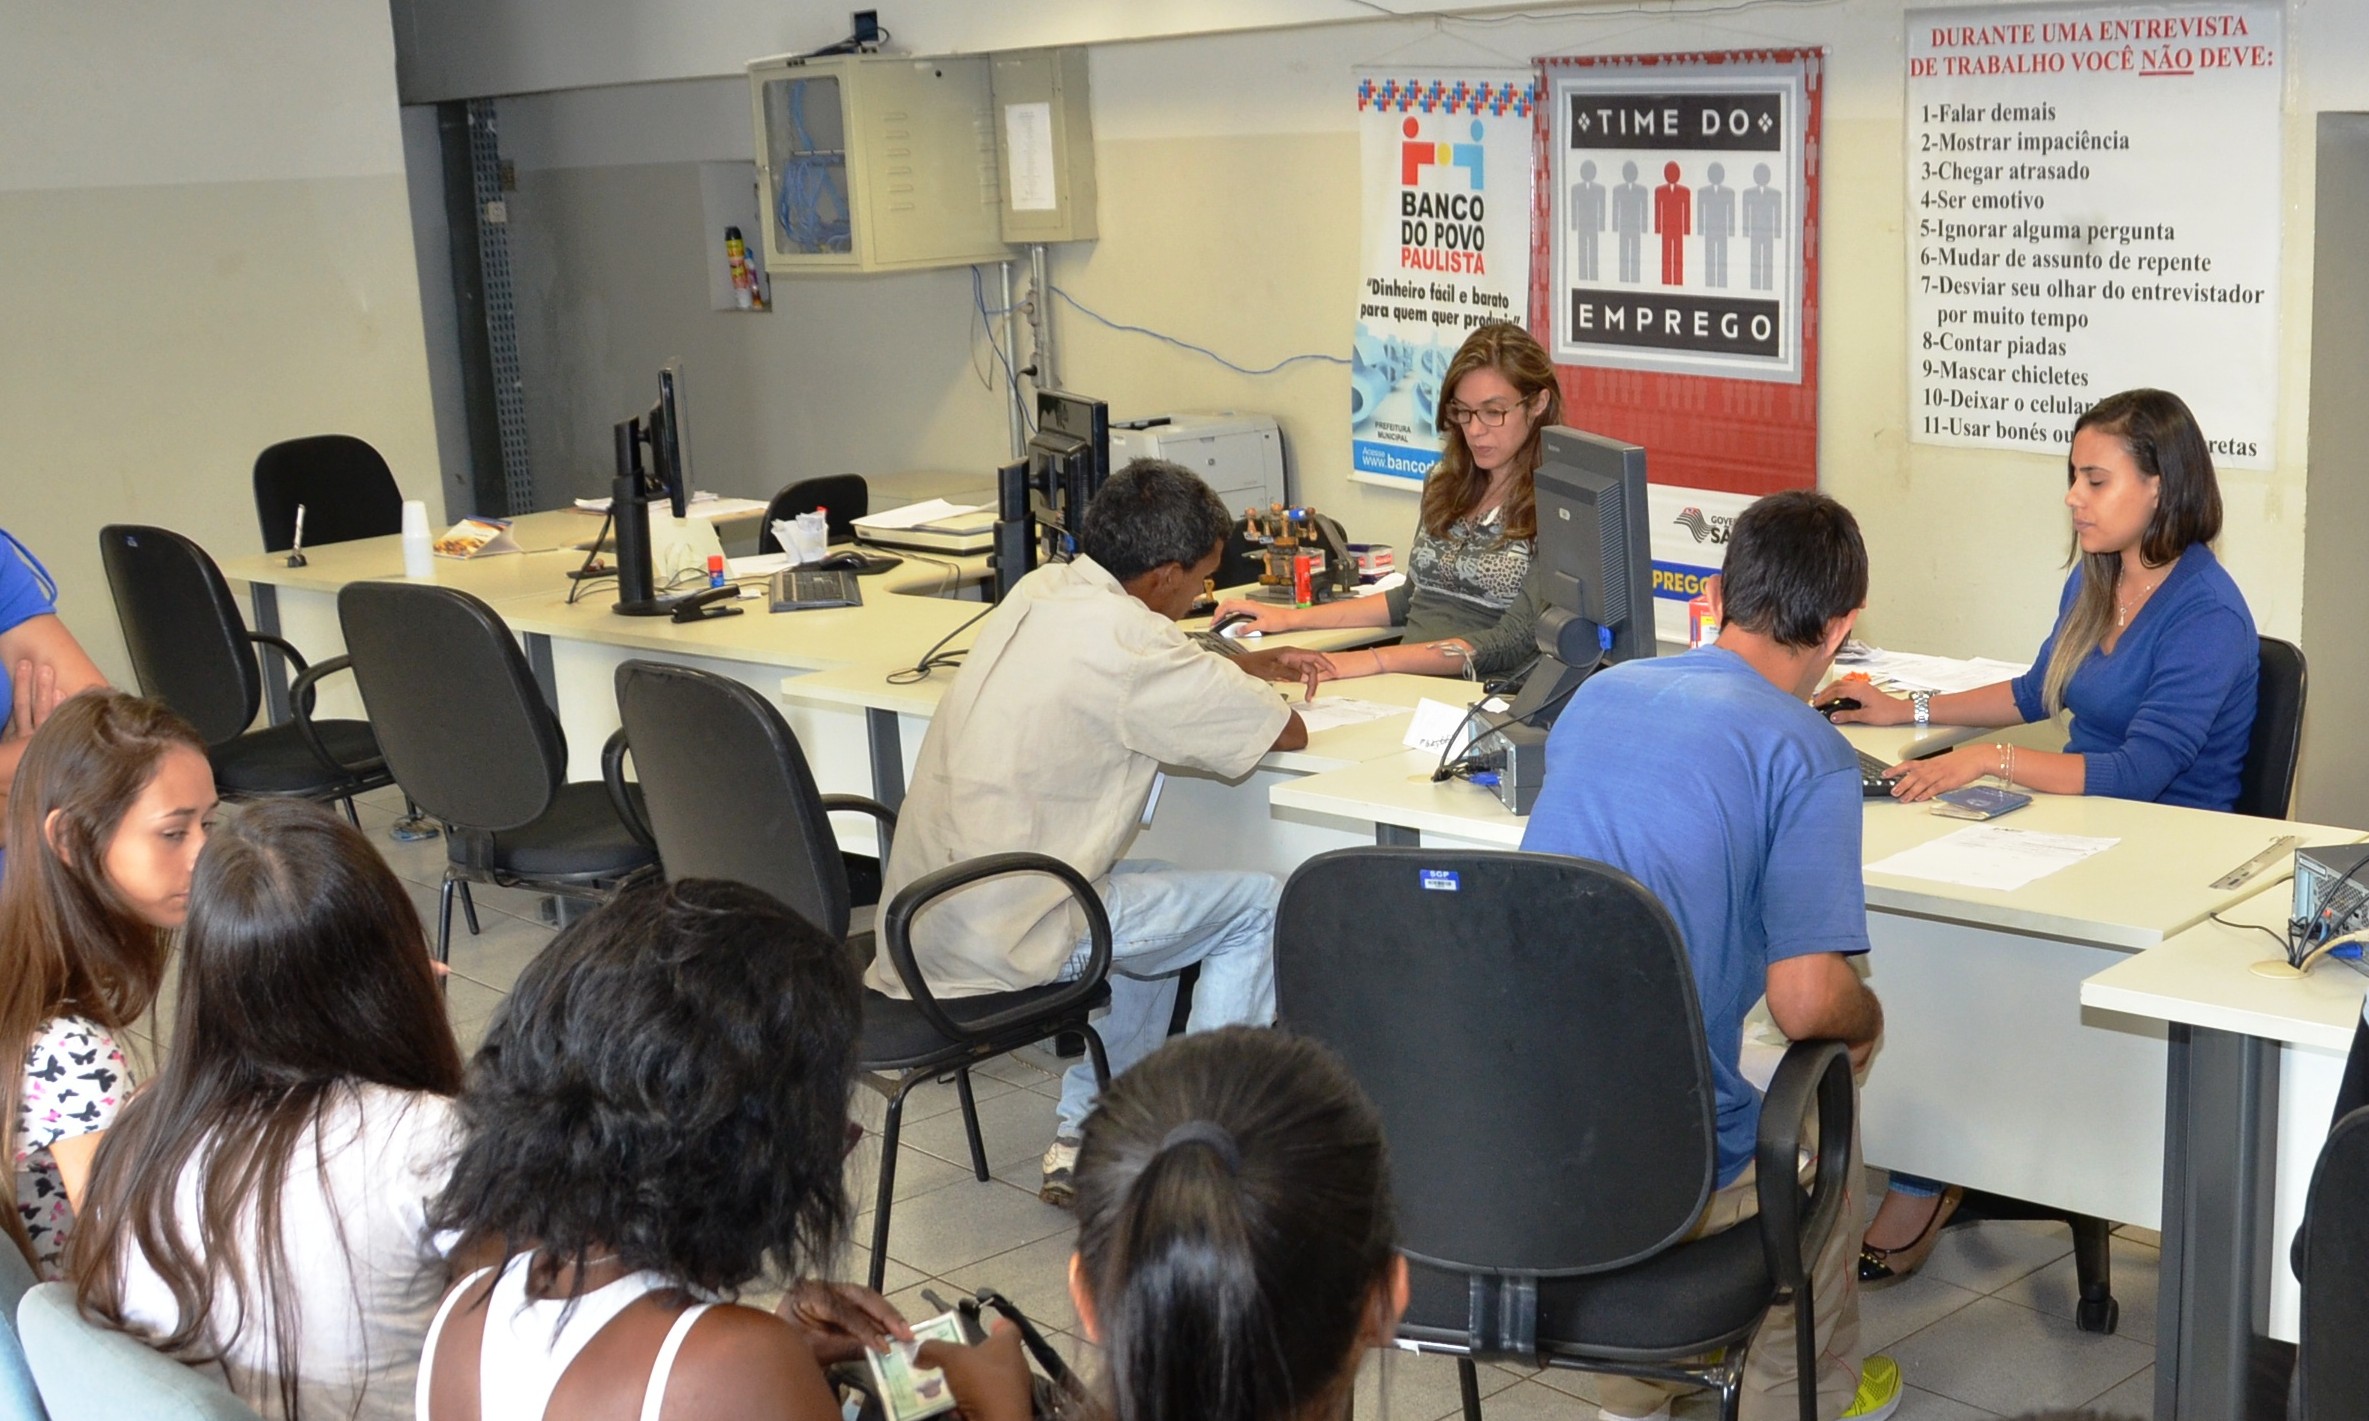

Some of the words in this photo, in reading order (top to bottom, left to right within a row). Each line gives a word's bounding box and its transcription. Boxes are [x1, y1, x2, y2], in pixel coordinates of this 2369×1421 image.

[1931, 24, 2035, 47] DURANTE
[2042, 22, 2094, 43] UMA
[2100, 15, 2249, 41] ENTREVISTA
[1910, 57, 1938, 77] DE
[1943, 52, 2065, 75] TRABALHO
[2072, 44, 2135, 71] VOCÊ
[2139, 44, 2194, 71] NÃO
[2199, 45, 2274, 69] DEVE:
[1597, 109, 1678, 135] TIME
[1702, 109, 1749, 136] DO
[1922, 104, 1986, 123] 1-Falar
[1991, 101, 2056, 122] demais
[1921, 133, 2012, 152] 2-Mostrar
[2017, 129, 2130, 156] impaciência
[1921, 161, 2003, 185] 3-Chegar
[2009, 160, 2090, 180] atrasado
[1401, 190, 1484, 222] BANCO
[1920, 189, 1967, 209] 4-Ser
[1972, 190, 2045, 210] emotivo
[1401, 220, 1427, 247] DO
[1435, 222, 1485, 251] POVO
[1920, 218, 2007, 243] 5-Ignorar
[2012, 220, 2081, 244] alguma
[2087, 222, 2175, 245] pergunta
[1401, 247, 1485, 275] PAULISTA
[1920, 248, 2001, 268] 6-Mudar
[2005, 249, 2027, 268] de
[2032, 252, 2103, 270] assunto
[2108, 250, 2132, 271] de
[2137, 253, 2212, 276] repente
[1430, 282, 1455, 303] fácil
[1459, 291, 1467, 304] e
[1472, 286, 1509, 309] barato
[1921, 275, 2006, 297] 7-Desviar
[2011, 281, 2040, 297] seu
[2047, 278, 2097, 299] olhar
[2102, 280, 2126, 301] do
[2132, 281, 2265, 304] entrevistador
[1360, 303, 1389, 319] para
[1393, 306, 1427, 323] quem
[1432, 310, 1460, 327] quer
[1579, 303, 1772, 341] EMPREGO
[1938, 308, 1968, 327] por
[1973, 306, 2025, 327] muito
[2031, 309, 2089, 332] tempo
[1923, 331, 2002, 353] 8-Contar
[2007, 338, 2067, 359] piadas
[1923, 359, 2006, 382] 9-Mascar
[2011, 364, 2089, 387] chicletes
[1923, 387, 2009, 411] 10-Deixar
[2014, 397, 2024, 412] o
[2030, 395, 2095, 415] celular
[1375, 422, 1411, 433] PREFEITURA
[1378, 432, 1408, 443] MUNICIPAL
[1923, 416, 1991, 438] 11-Usar
[1996, 421, 2047, 442] bonés
[1363, 447, 1386, 457] Acesse
